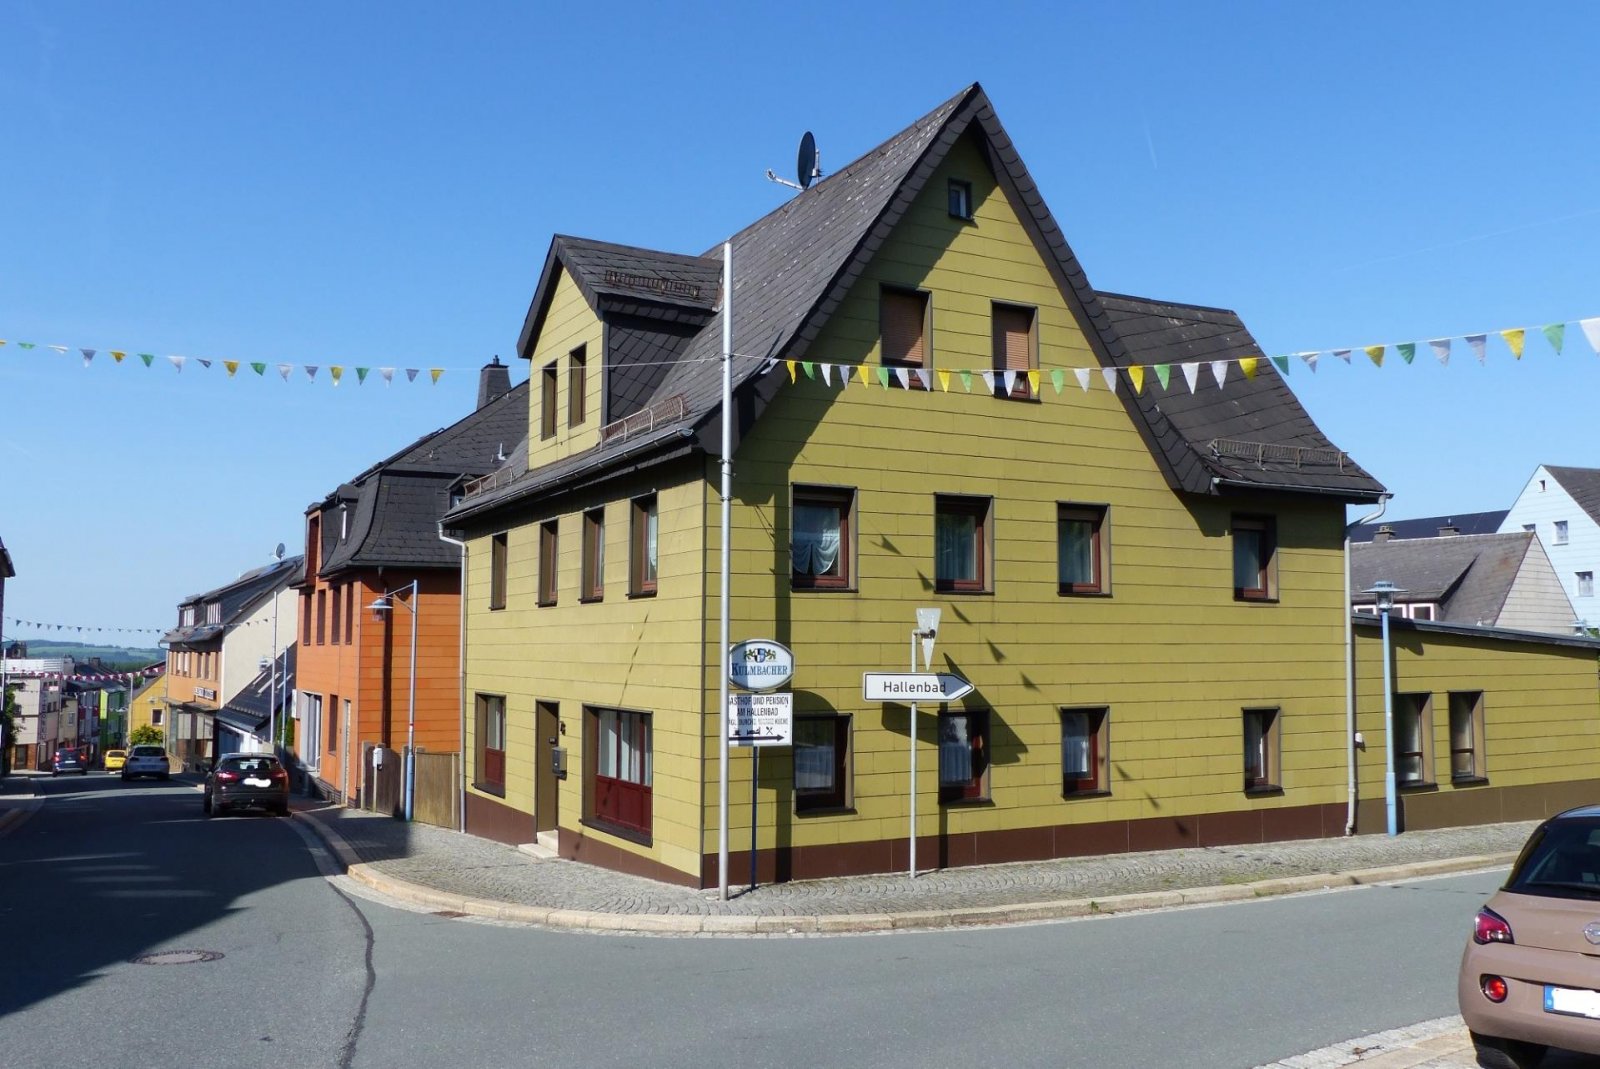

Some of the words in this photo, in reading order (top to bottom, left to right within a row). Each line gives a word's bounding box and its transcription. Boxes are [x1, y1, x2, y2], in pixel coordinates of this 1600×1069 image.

[731, 662, 788, 676] KULMBACHER
[883, 681, 946, 693] Hallenbad
[729, 696, 752, 706] ASTHOF
[753, 696, 765, 705] UND
[766, 696, 789, 705] PENSION
[737, 707, 746, 716] AM
[747, 707, 778, 716] HALLENBAD
